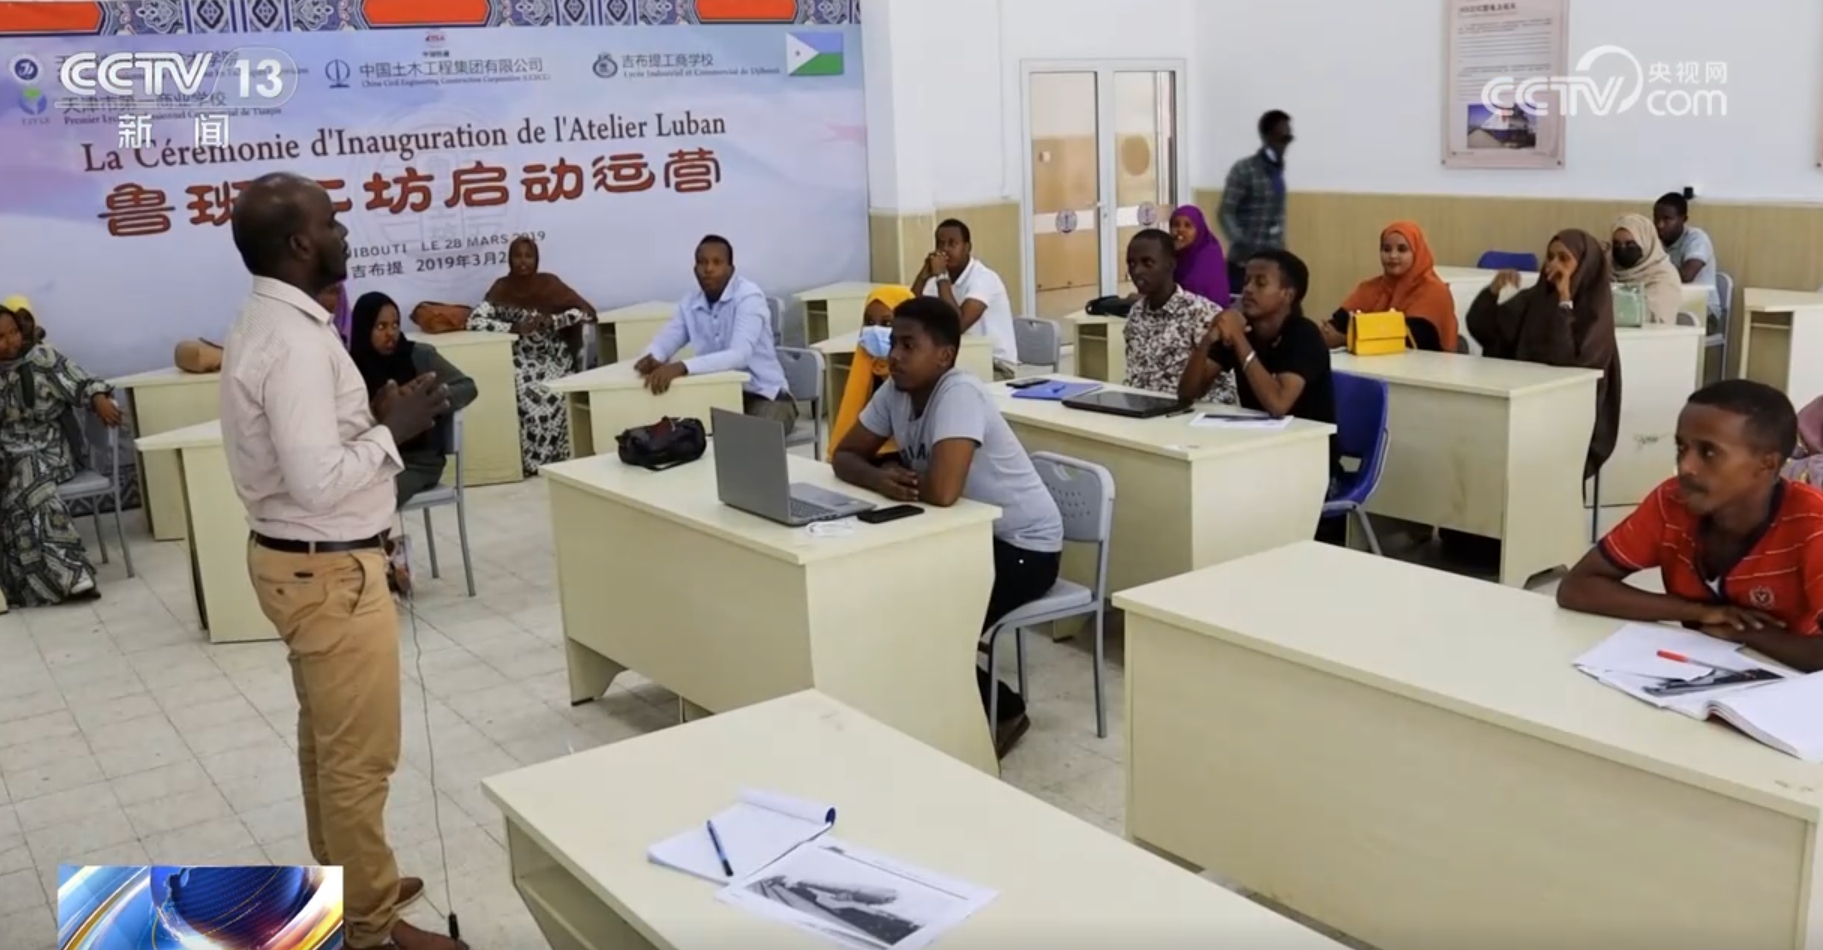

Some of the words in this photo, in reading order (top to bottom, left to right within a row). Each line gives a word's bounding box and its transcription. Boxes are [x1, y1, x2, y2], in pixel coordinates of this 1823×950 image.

[359, 57, 544, 78] 中国土木工程集团有限公司
[622, 53, 714, 68] 吉布提工商学校
[64, 114, 100, 125] Premier
[81, 143, 123, 173] La
[133, 134, 300, 168] Cérémonie
[311, 123, 508, 161] d'Inauguration
[517, 117, 546, 145] de
[555, 113, 648, 142] l'Atelier
[655, 110, 727, 138] Luban
[348, 243, 407, 259] IBOUTI
[421, 241, 441, 252] LE
[445, 238, 462, 250] 28
[467, 233, 509, 248] MARS
[351, 260, 405, 279] 吉布提
[416, 251, 508, 272] 2019年3月2
